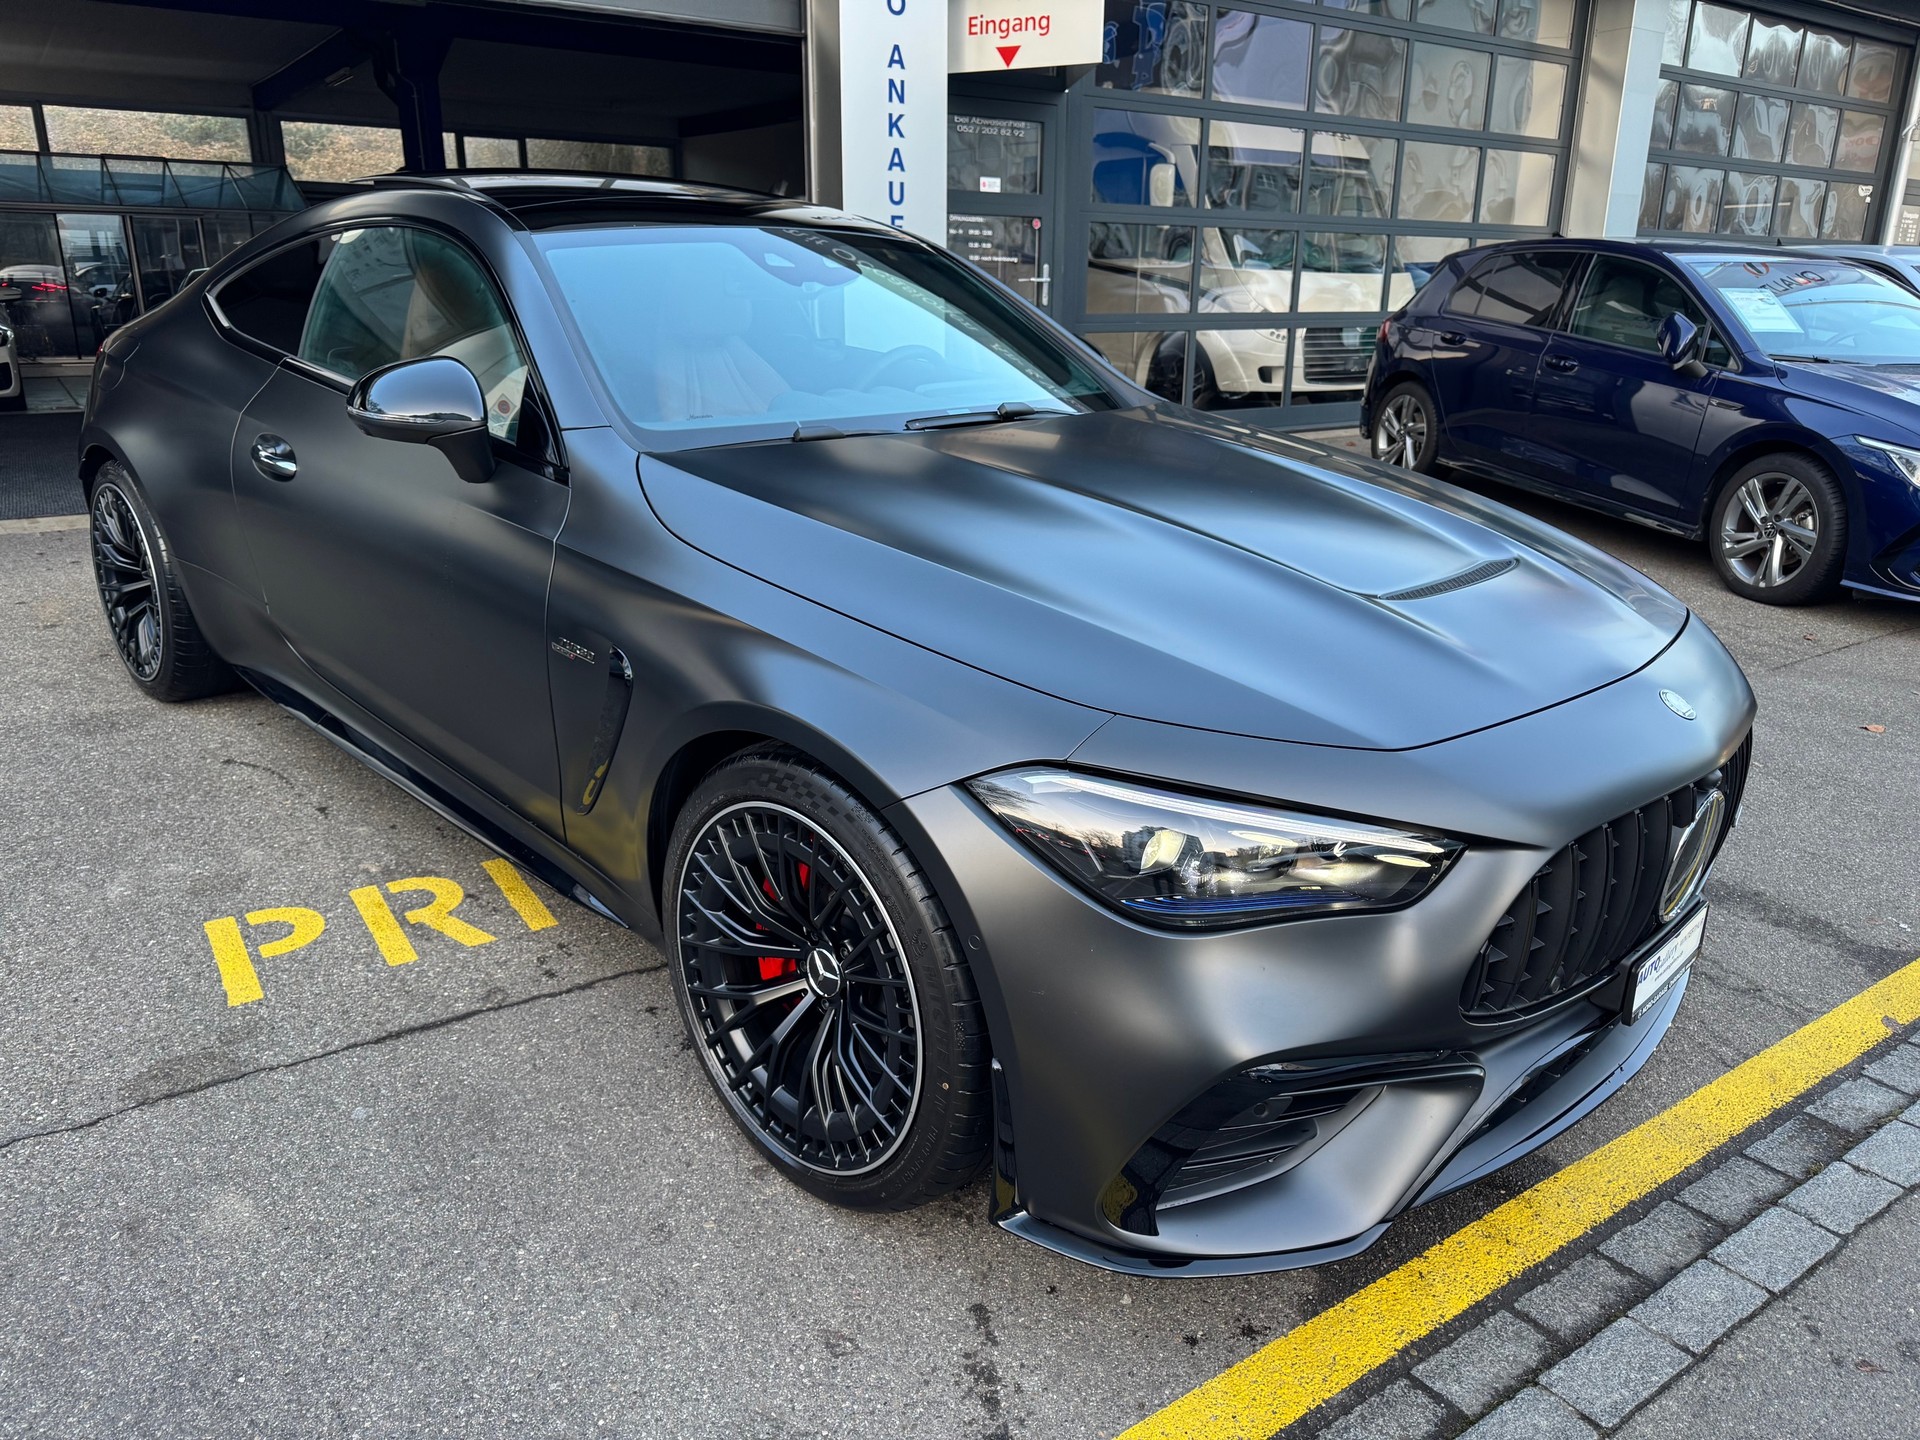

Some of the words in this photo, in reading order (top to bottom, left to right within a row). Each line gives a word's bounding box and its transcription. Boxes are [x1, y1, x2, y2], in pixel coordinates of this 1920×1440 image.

[967, 14, 1050, 39] Eingang
[981, 127, 999, 135] 202
[203, 858, 559, 1006] PRI
